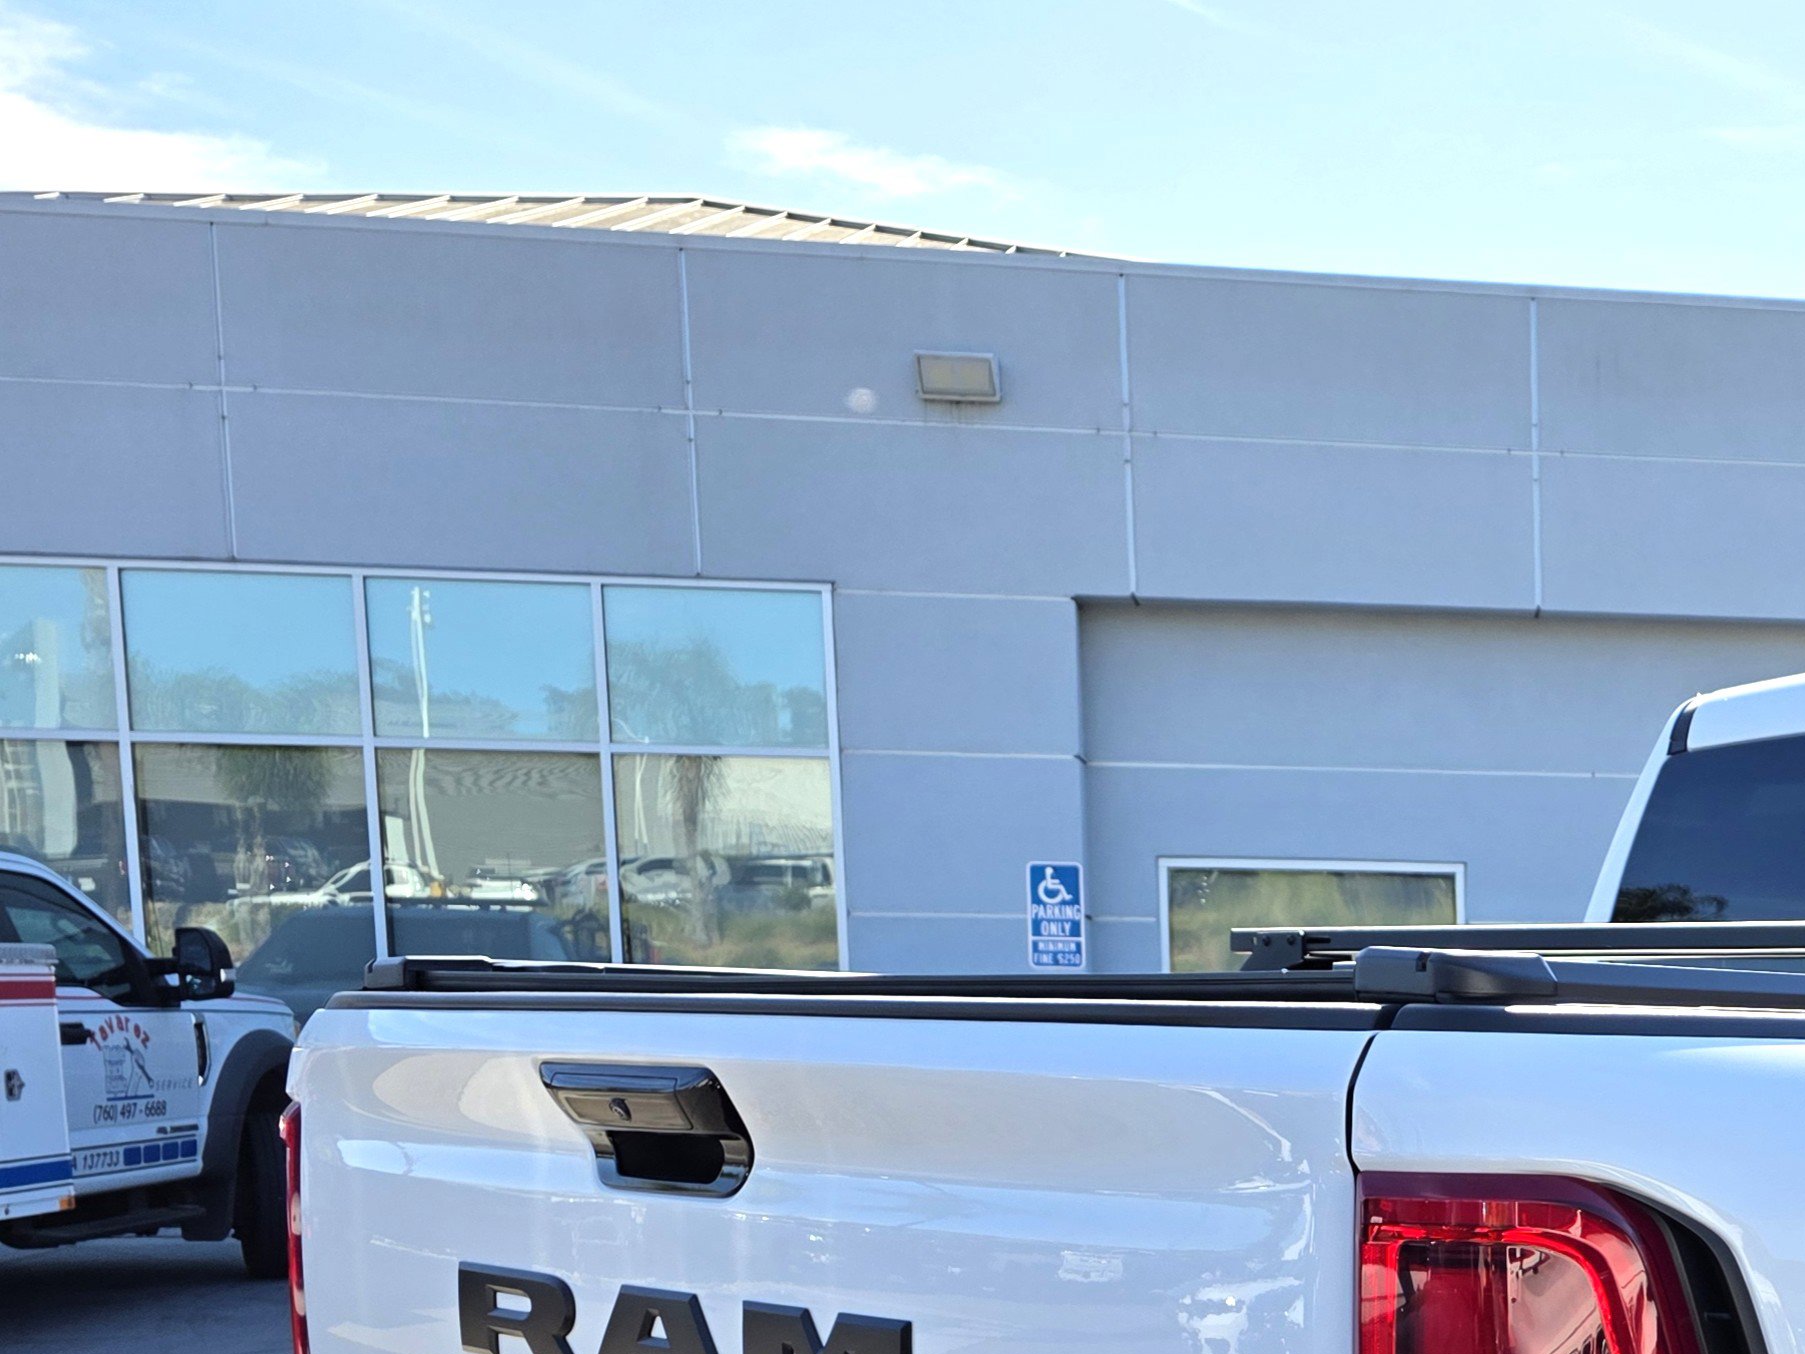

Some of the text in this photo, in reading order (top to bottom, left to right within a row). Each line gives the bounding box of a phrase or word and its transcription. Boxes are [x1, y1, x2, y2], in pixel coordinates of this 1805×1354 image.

[1031, 904, 1081, 920] PARKING
[1041, 921, 1072, 936] ONLY
[1037, 942, 1077, 952] MINIMUM
[1033, 953, 1081, 964] FINE $250
[155, 1079, 193, 1092] SERVICE
[93, 1104, 118, 1124] (760)
